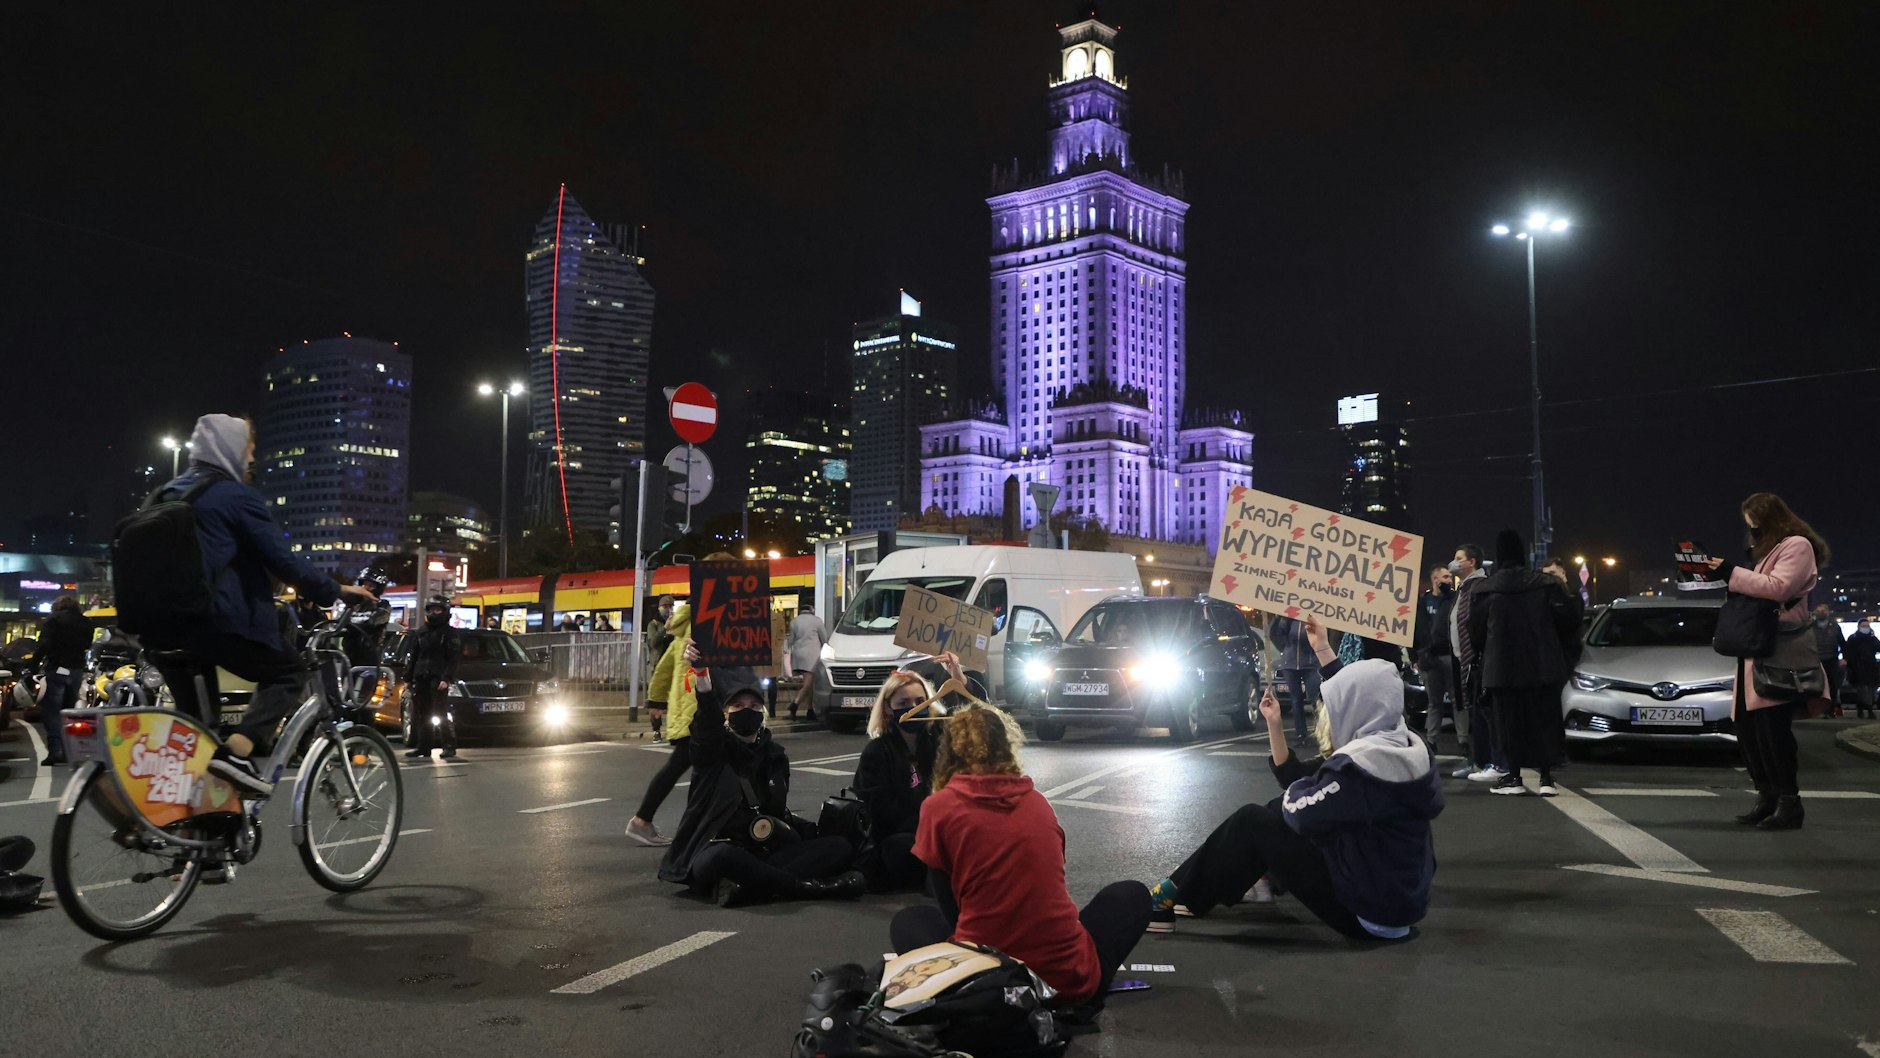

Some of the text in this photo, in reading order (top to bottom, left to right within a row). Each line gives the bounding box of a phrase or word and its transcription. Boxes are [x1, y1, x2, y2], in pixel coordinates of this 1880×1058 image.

[1239, 502, 1388, 558] KAJA GODEK
[1223, 525, 1414, 604] WYPIERDALAJ
[727, 575, 759, 593] TO
[1234, 562, 1355, 600] ZIMNEJ KAWUSI
[728, 596, 771, 622] JEST
[912, 589, 989, 629] TO JEST
[717, 626, 772, 650] WOJNA
[1083, 684, 1108, 693] 27934
[1639, 709, 1700, 721] WZ 7346M
